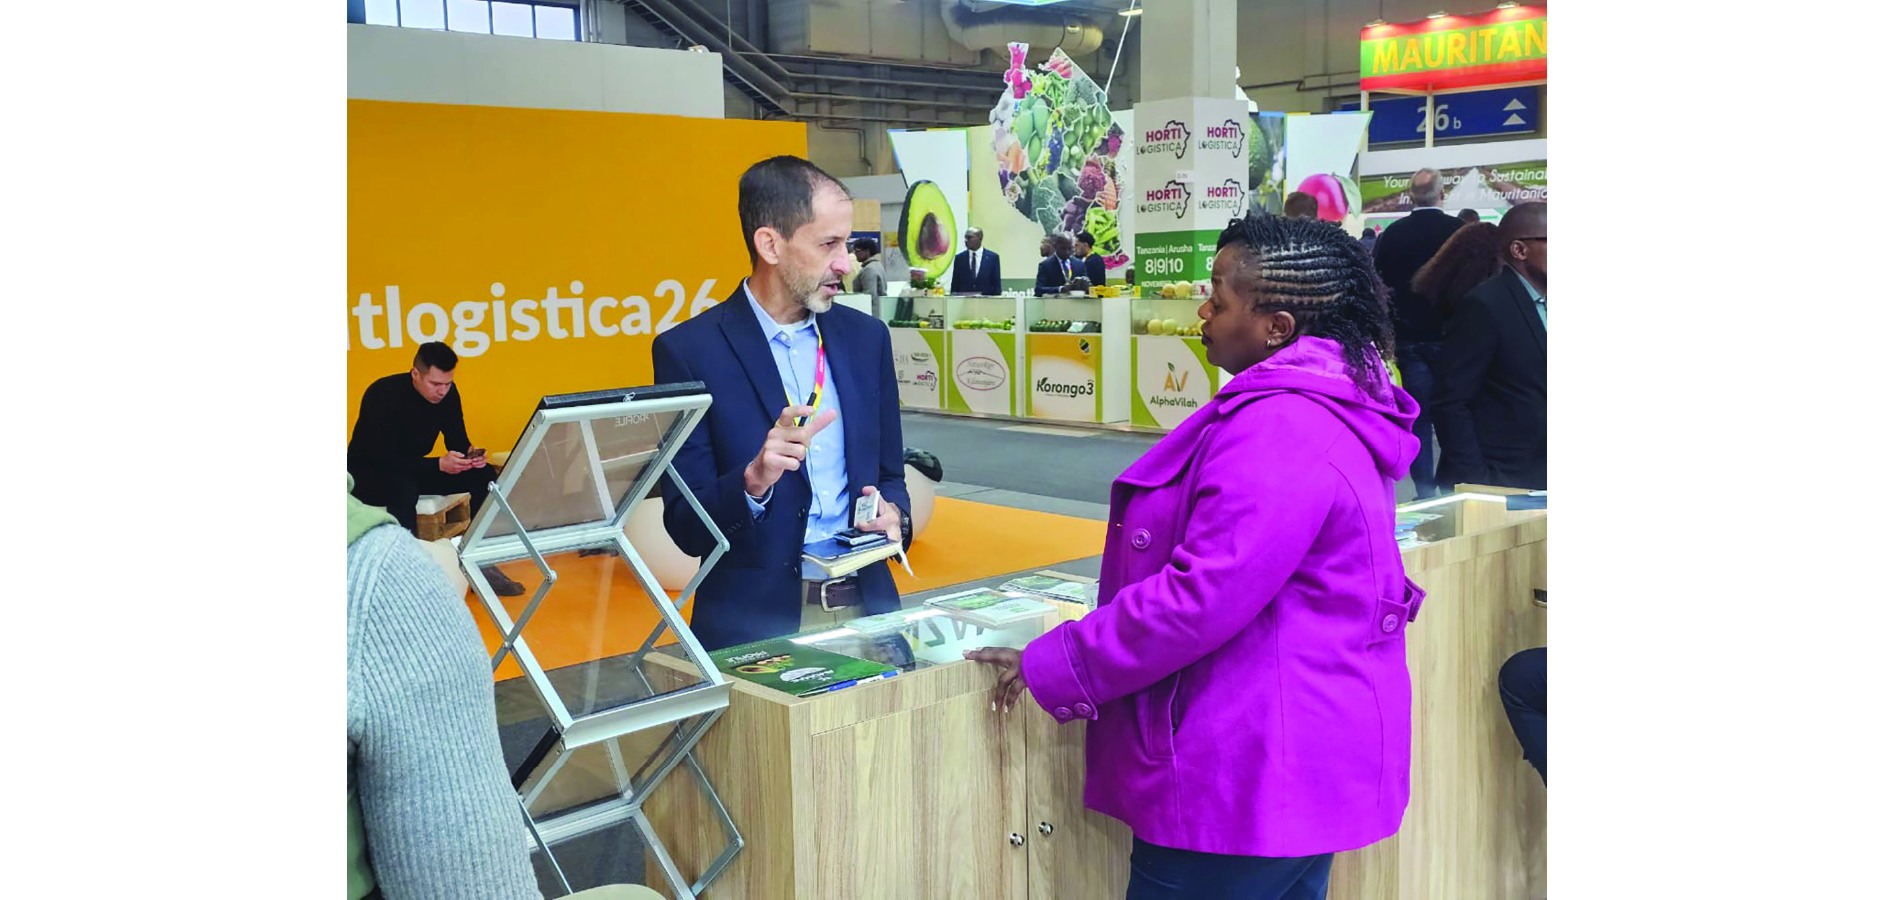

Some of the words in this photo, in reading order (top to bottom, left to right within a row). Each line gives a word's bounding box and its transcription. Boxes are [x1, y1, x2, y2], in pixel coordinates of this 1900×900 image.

[1373, 21, 1547, 74] MAURITAN
[1146, 128, 1181, 142] HORTI
[1207, 126, 1238, 139] HORTI
[1136, 142, 1182, 155] LOGISTICA
[1198, 140, 1238, 150] LOGISTICA
[1384, 175, 1410, 188] Your
[1146, 188, 1181, 201] HORTI
[1207, 186, 1238, 198] HORTI
[1136, 202, 1182, 213] LOGISTICA
[1198, 200, 1238, 210] LOGISTICA
[347, 278, 720, 358] tlogistica26
[1036, 377, 1094, 399] Korongo3
[1150, 395, 1198, 409] AlphaVilah
